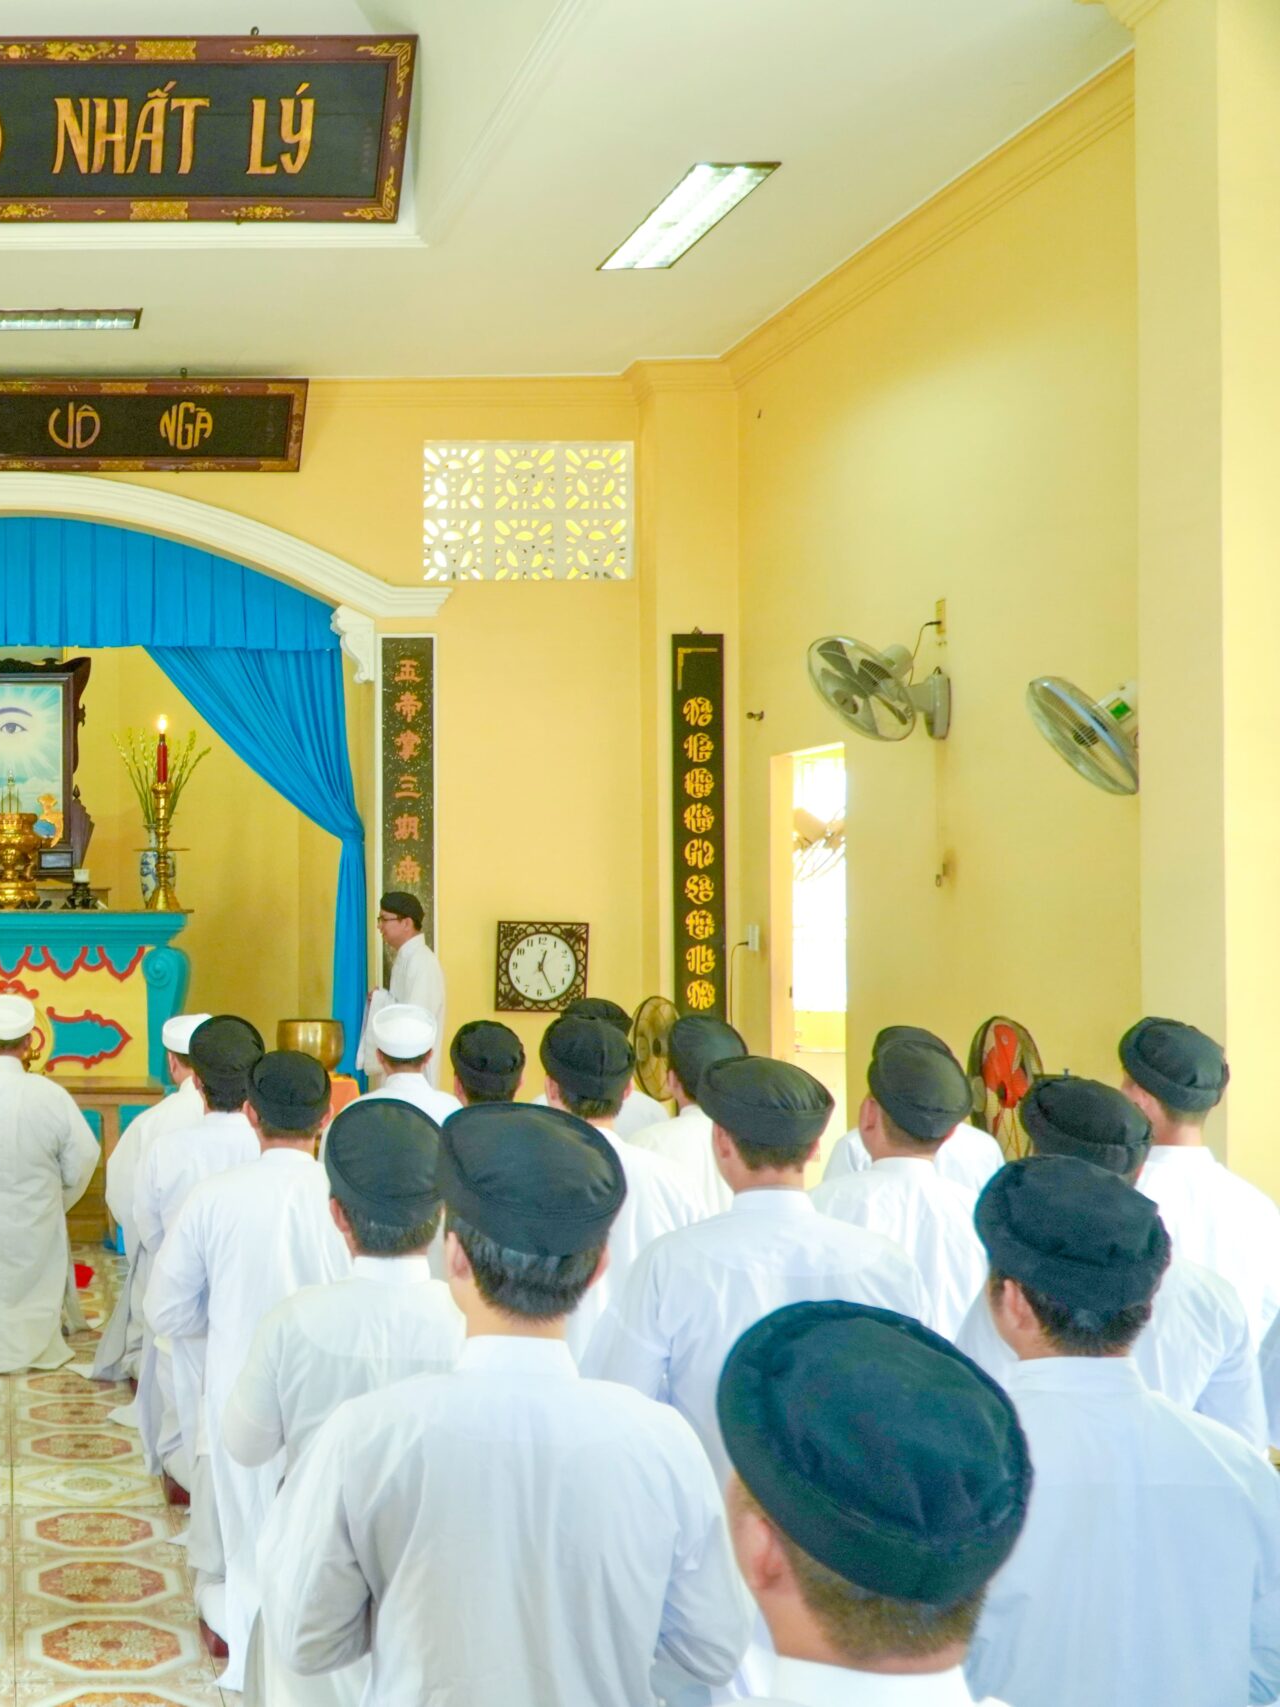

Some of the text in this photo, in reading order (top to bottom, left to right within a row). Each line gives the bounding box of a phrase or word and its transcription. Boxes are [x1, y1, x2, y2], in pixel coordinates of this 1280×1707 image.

[53, 82, 211, 176] NHẤT
[246, 83, 315, 177] LÝ
[48, 401, 101, 449] VÔ
[159, 401, 214, 450] NGÃ
